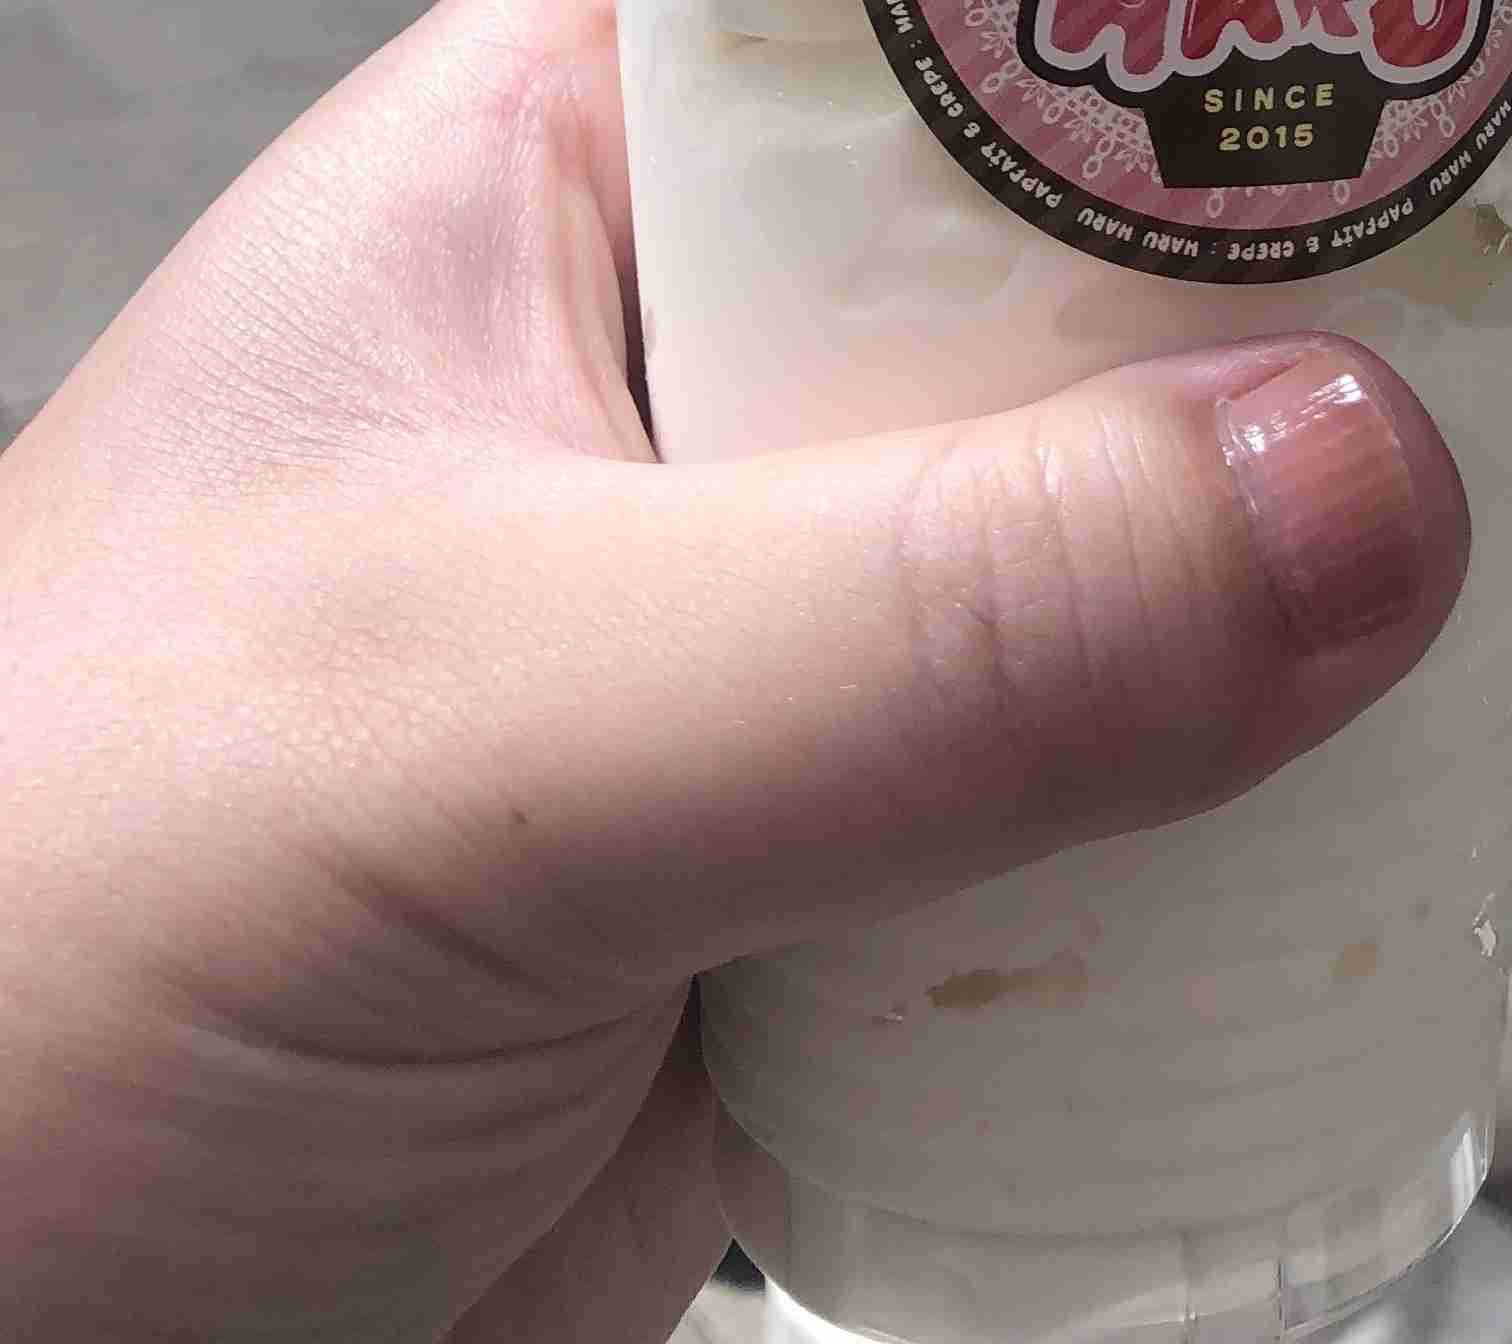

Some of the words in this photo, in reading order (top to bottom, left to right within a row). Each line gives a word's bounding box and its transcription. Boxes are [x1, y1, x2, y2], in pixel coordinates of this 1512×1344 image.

[1205, 83, 1334, 113] SINCE
[1219, 123, 1314, 152] 2015
[1077, 208, 1134, 241] HARU
[1142, 231, 1199, 257] HARU
